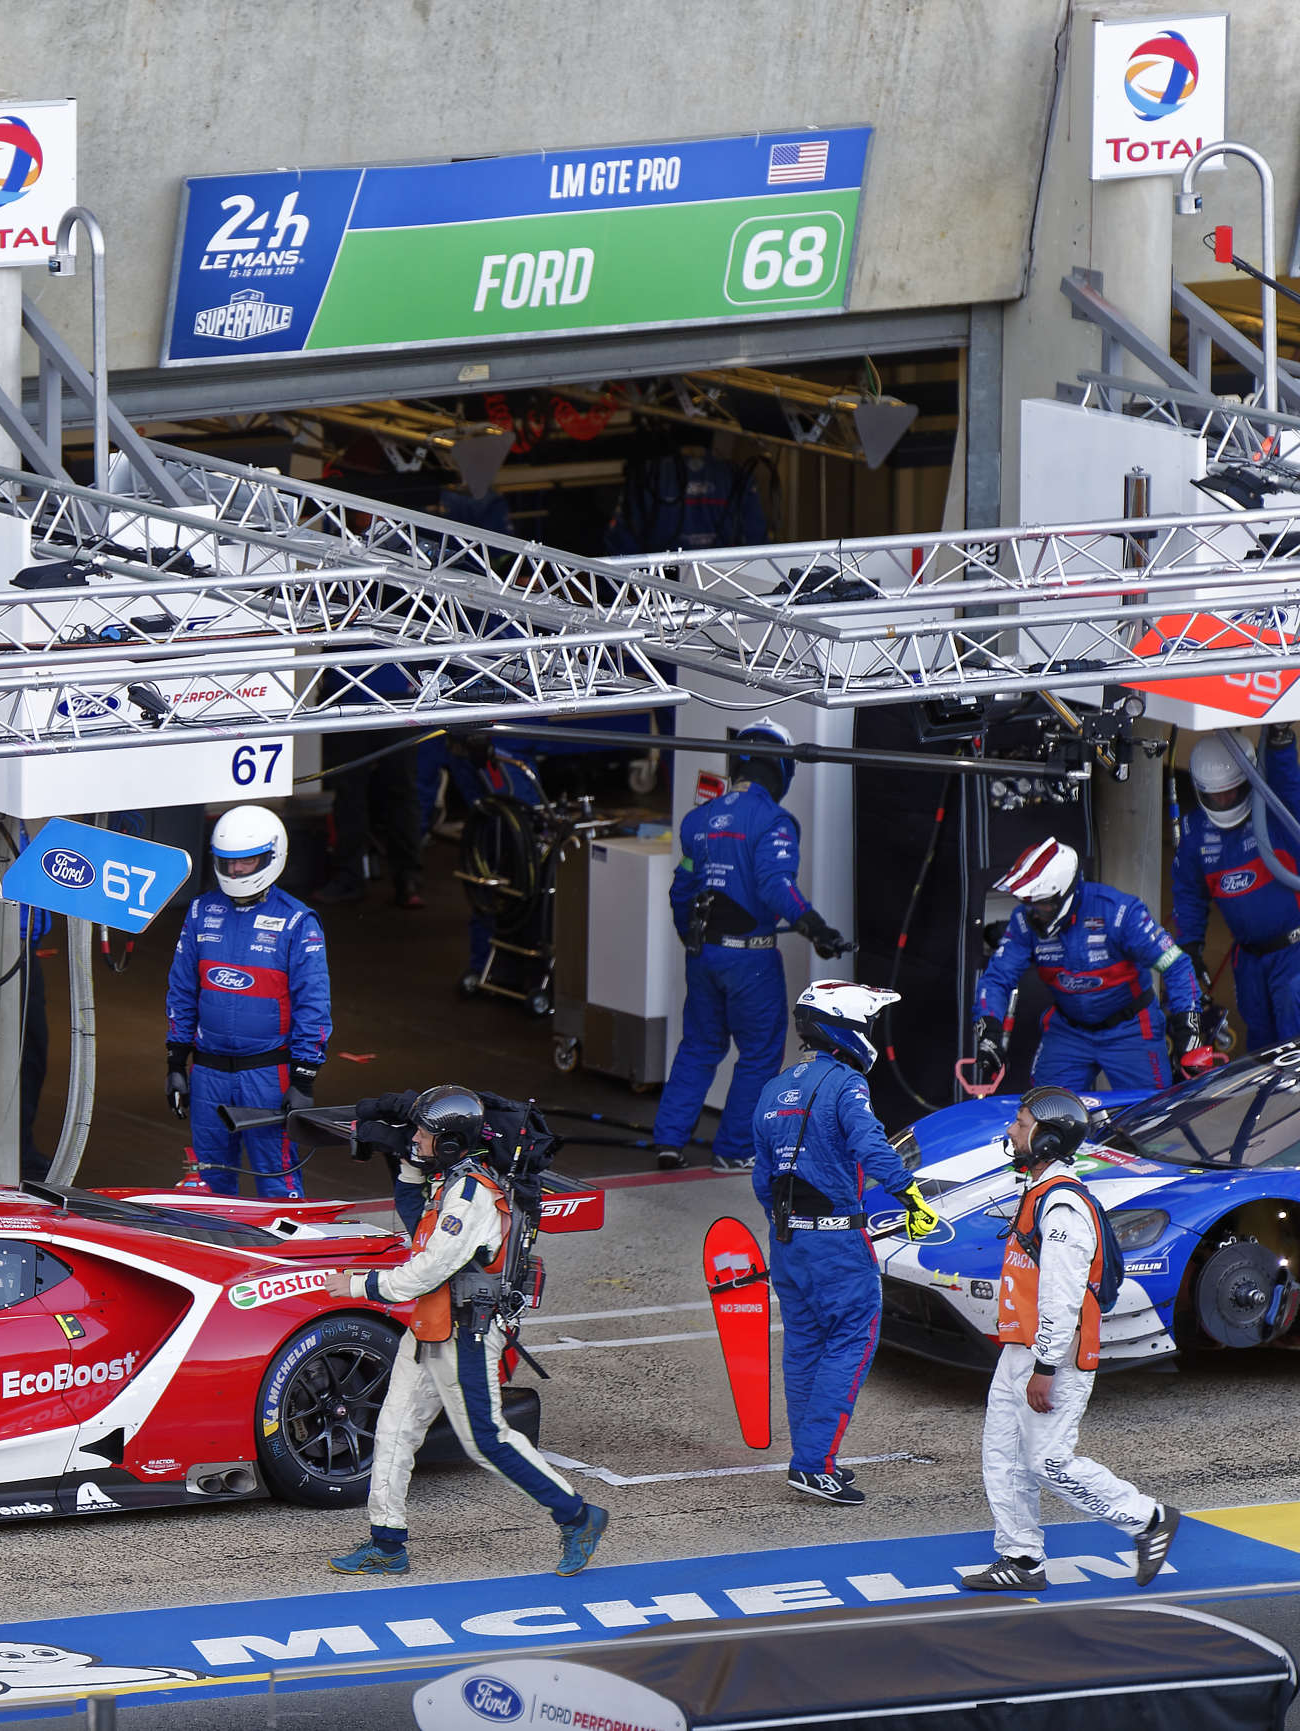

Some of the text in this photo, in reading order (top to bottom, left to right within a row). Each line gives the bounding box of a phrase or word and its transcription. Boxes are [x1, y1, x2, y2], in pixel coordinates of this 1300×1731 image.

[549, 156, 681, 199] LM GTE PRO
[206, 191, 310, 252] 24h
[200, 250, 301, 270] LE MANS
[741, 226, 828, 291] 68
[473, 247, 595, 312] FORD
[195, 302, 291, 338] SUPERFINALE
[173, 687, 267, 704] PERFORMANCE
[232, 743, 283, 786] 67
[52, 852, 86, 884] Ford
[103, 859, 156, 907] 67
[215, 969, 245, 987] Ford
[1261, 1042, 1300, 1067] FO
[784, 1090, 800, 1104] For
[763, 1110, 778, 1121] FOR
[441, 1216, 463, 1235] FIA
[1125, 1262, 1162, 1272] CHELIN
[721, 1303, 763, 1313] ENGINE ON
[2, 1351, 135, 1398] EcoBoost
[268, 1335, 318, 1404] MICHELIN
[76, 1502, 122, 1511] AXALTA
[474, 1681, 512, 1716] Ford
[541, 1703, 572, 1725] FORD
